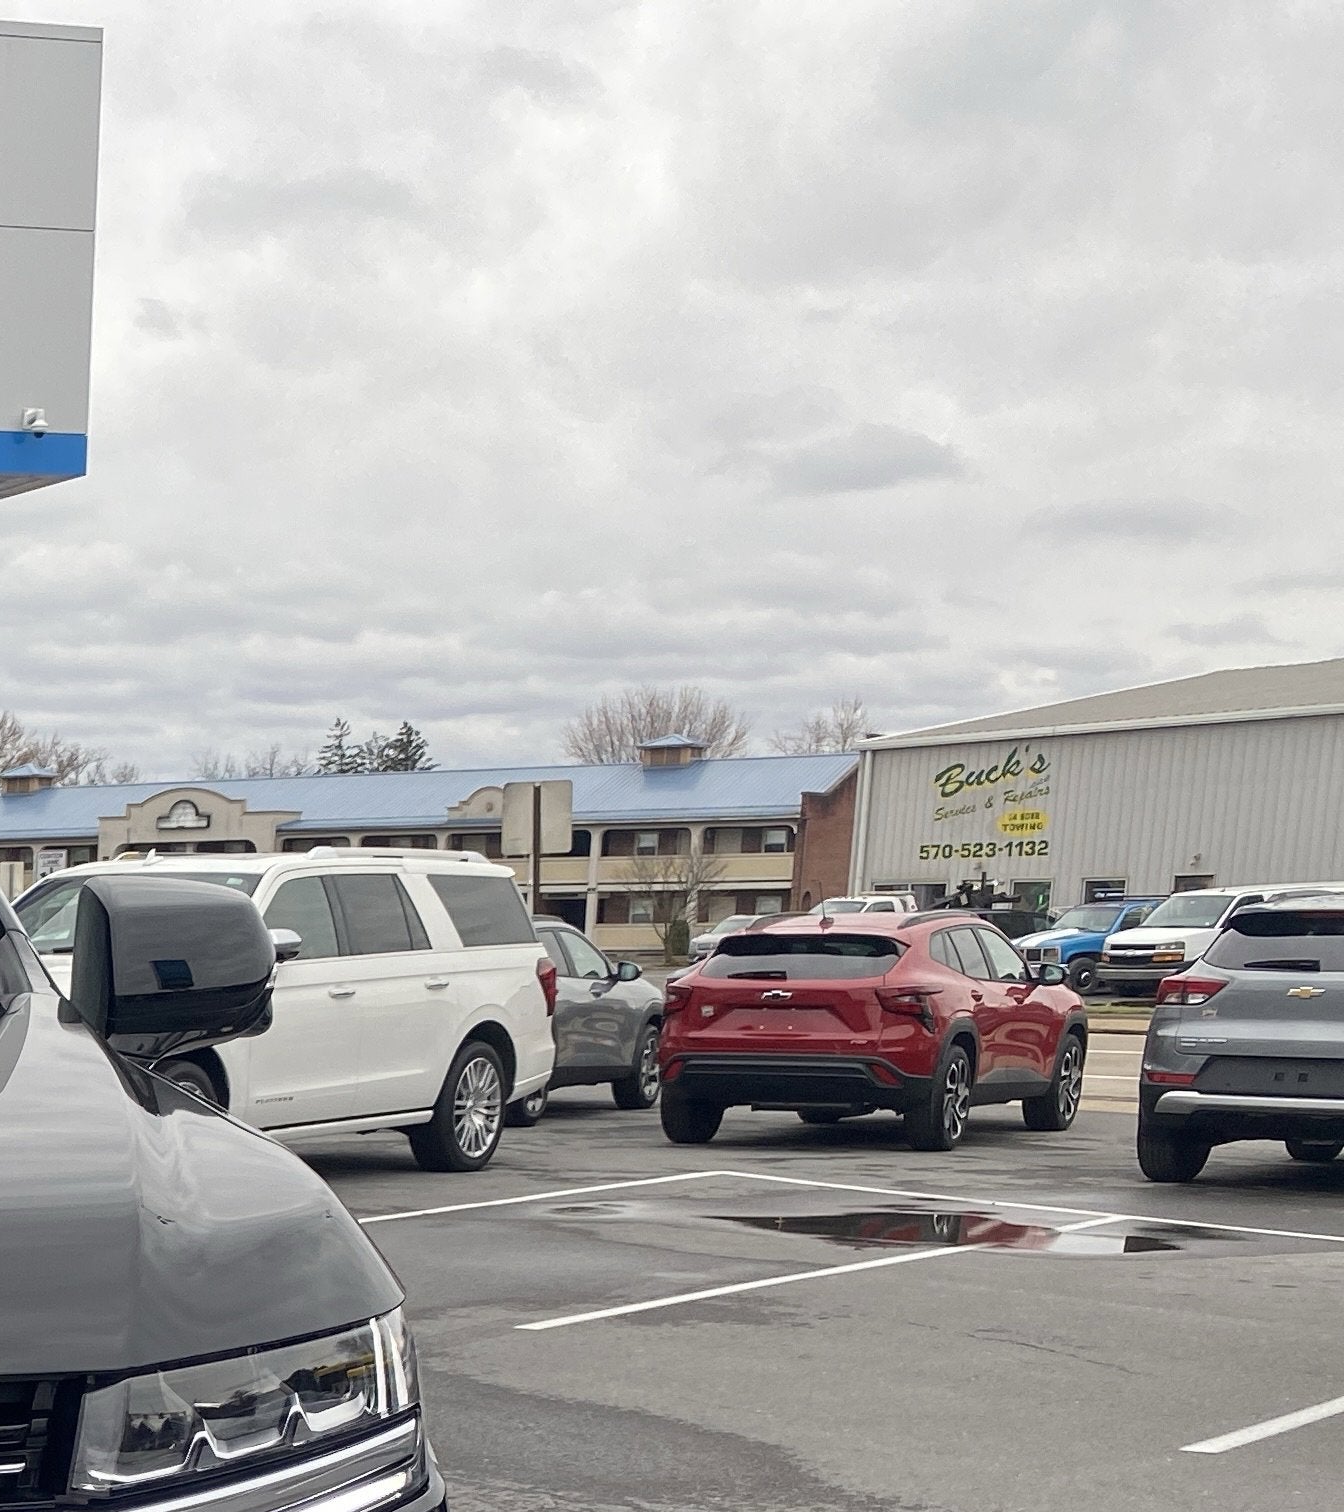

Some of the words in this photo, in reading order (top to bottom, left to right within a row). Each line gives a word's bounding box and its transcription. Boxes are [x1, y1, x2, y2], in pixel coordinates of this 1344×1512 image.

[933, 744, 1052, 798] Buck's
[985, 795, 994, 809] &
[1001, 822, 1044, 832] TOWING
[919, 840, 1049, 860] 570-523-1132
